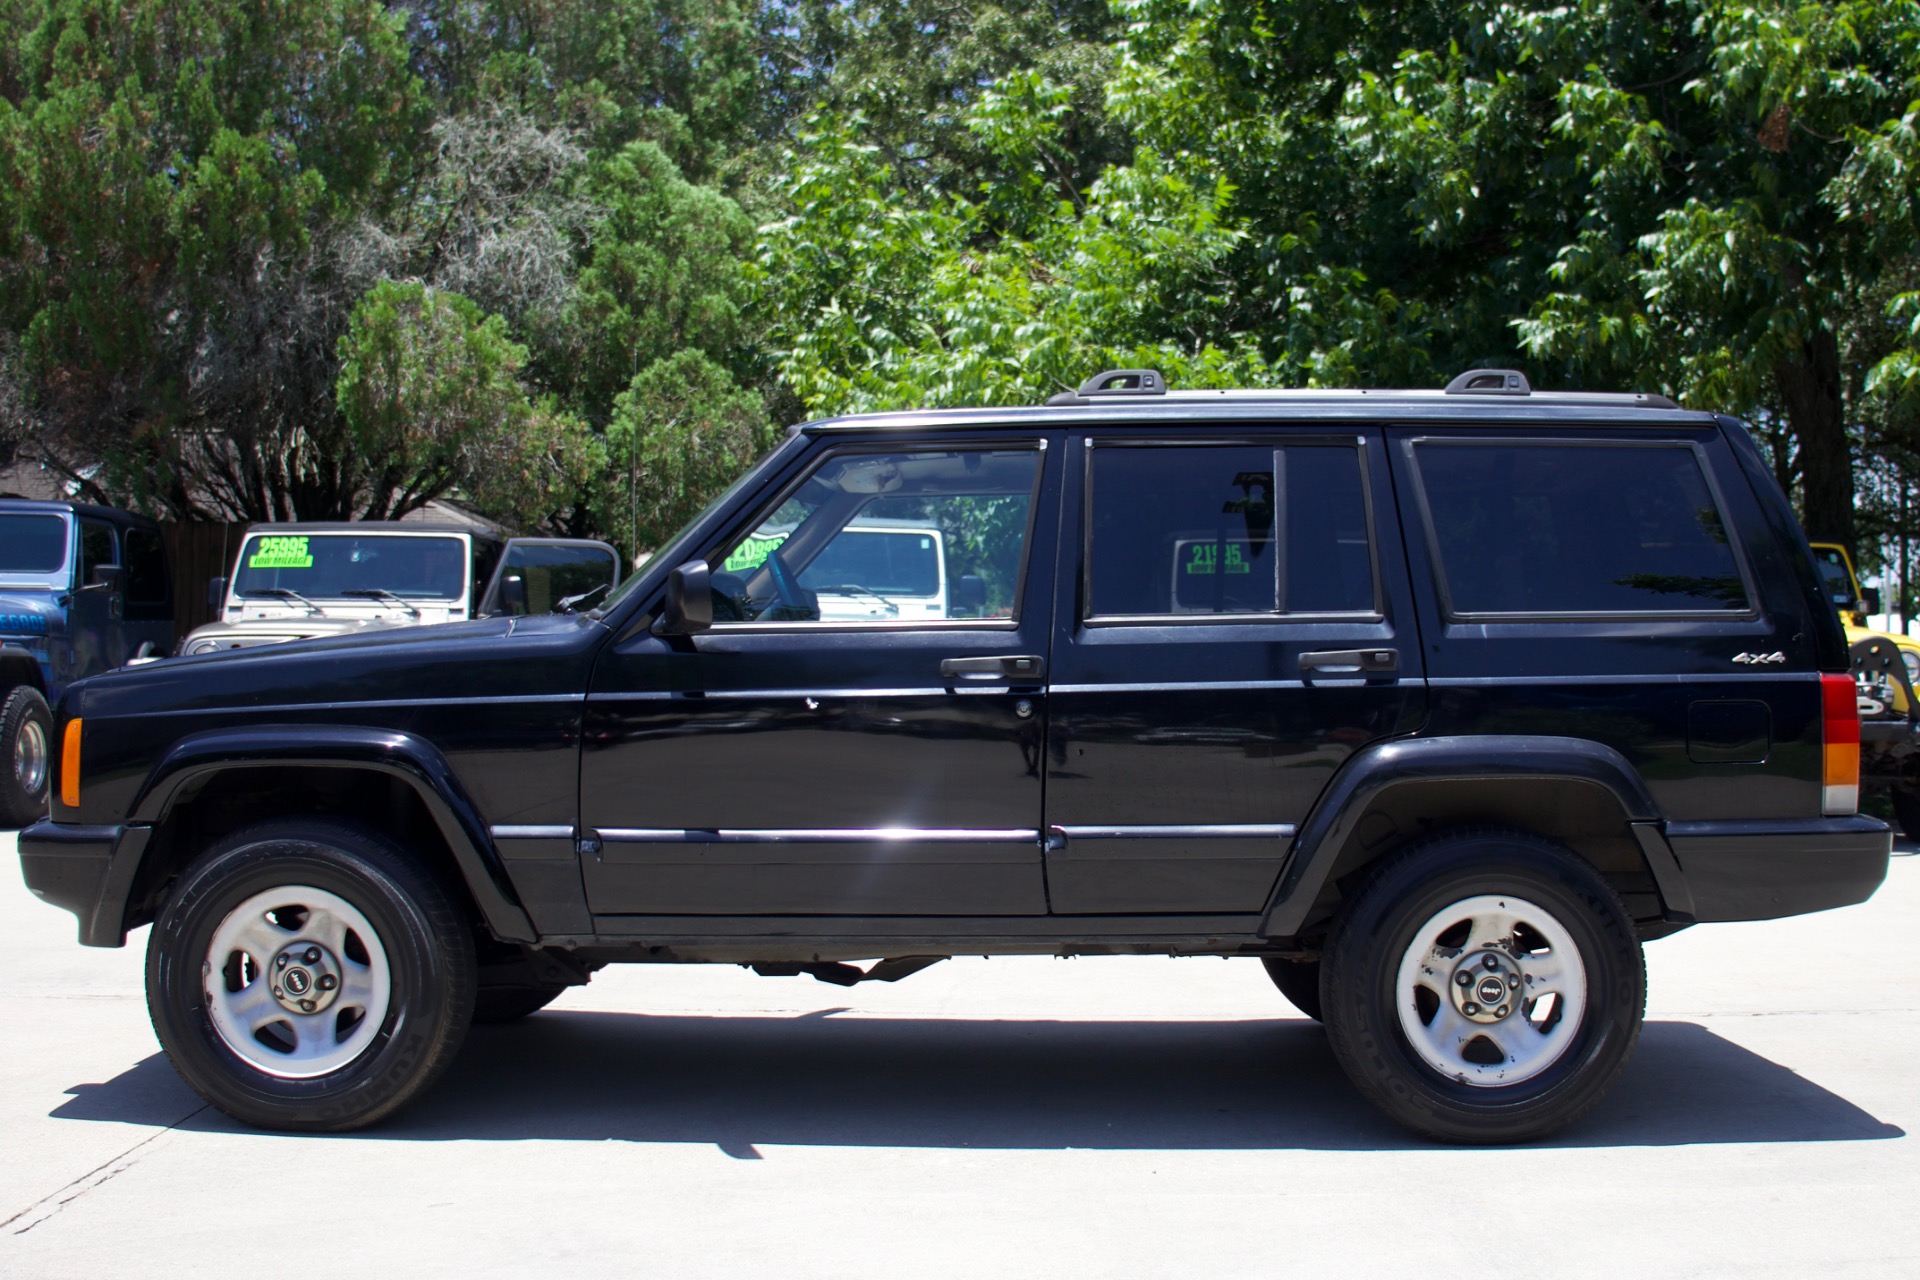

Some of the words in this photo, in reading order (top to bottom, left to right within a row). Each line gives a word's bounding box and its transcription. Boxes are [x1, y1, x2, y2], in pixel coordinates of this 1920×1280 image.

[259, 537, 309, 557] 25995
[291, 972, 303, 990] Jeep
[1482, 986, 1500, 995] Jeep
[315, 1033, 423, 1117] KUMHO
